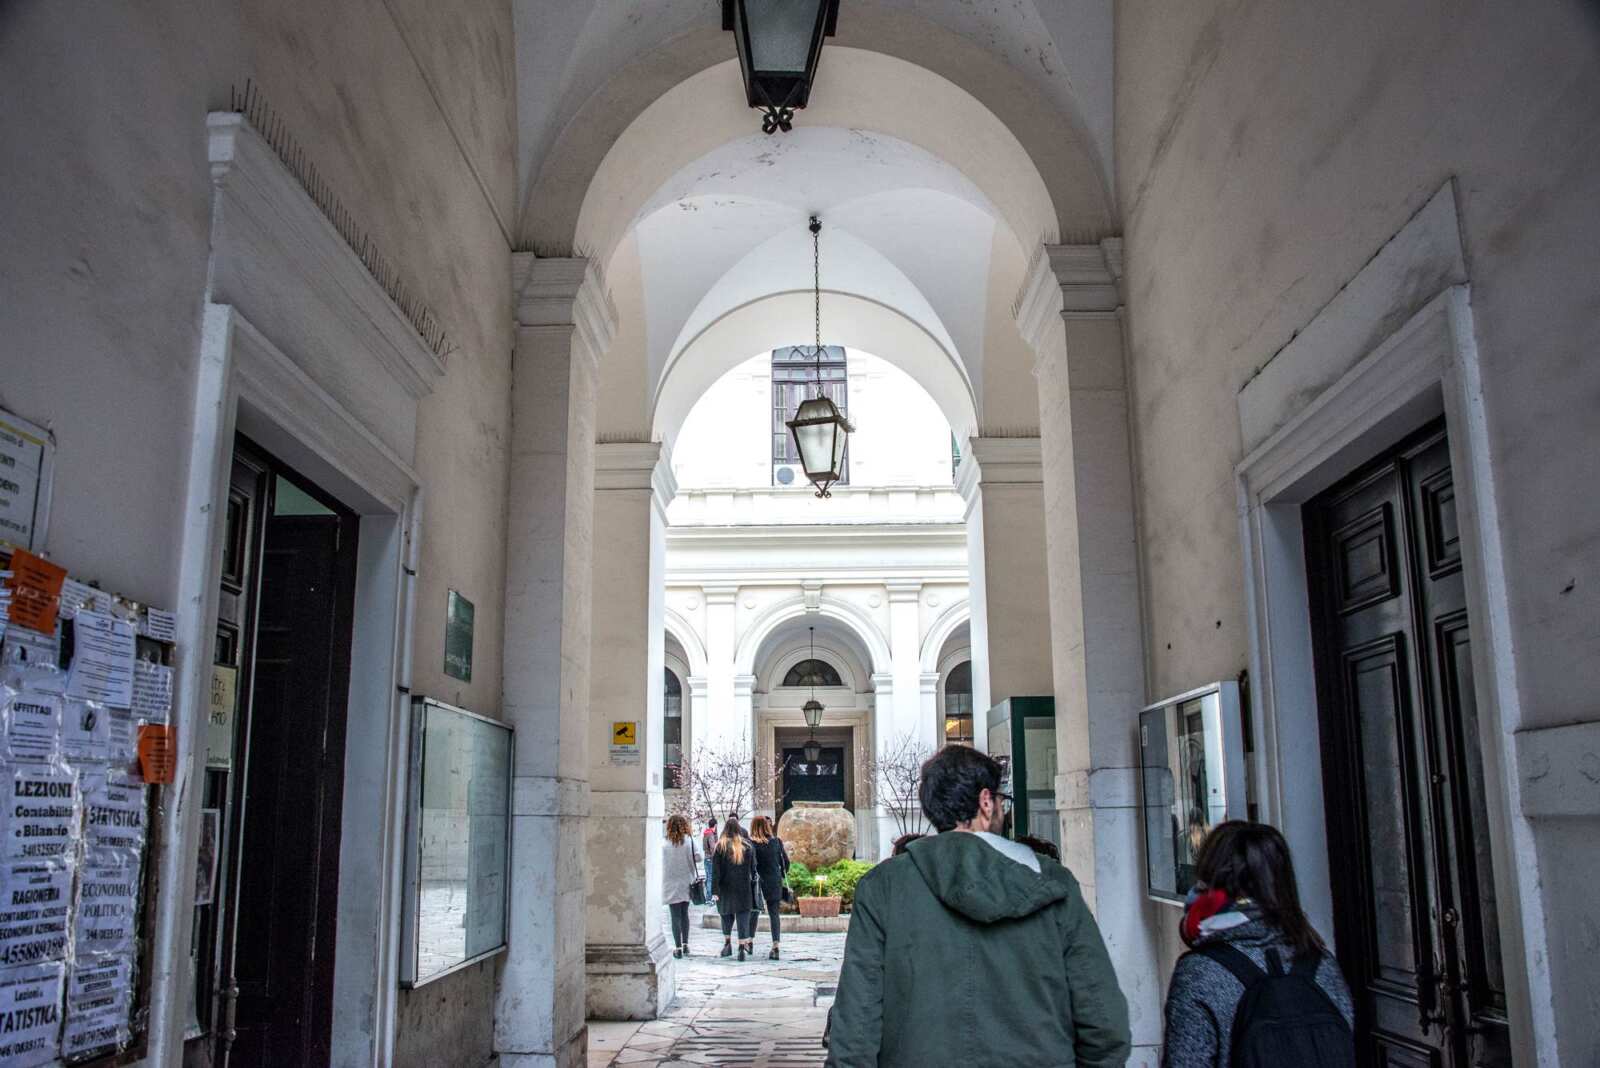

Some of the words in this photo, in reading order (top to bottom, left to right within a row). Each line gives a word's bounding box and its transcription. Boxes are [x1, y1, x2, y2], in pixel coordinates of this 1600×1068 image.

[15, 780, 73, 798] LEZIONI
[89, 806, 140, 828] STATISTICA
[15, 829, 22, 837] e
[23, 824, 68, 837] Bilancio
